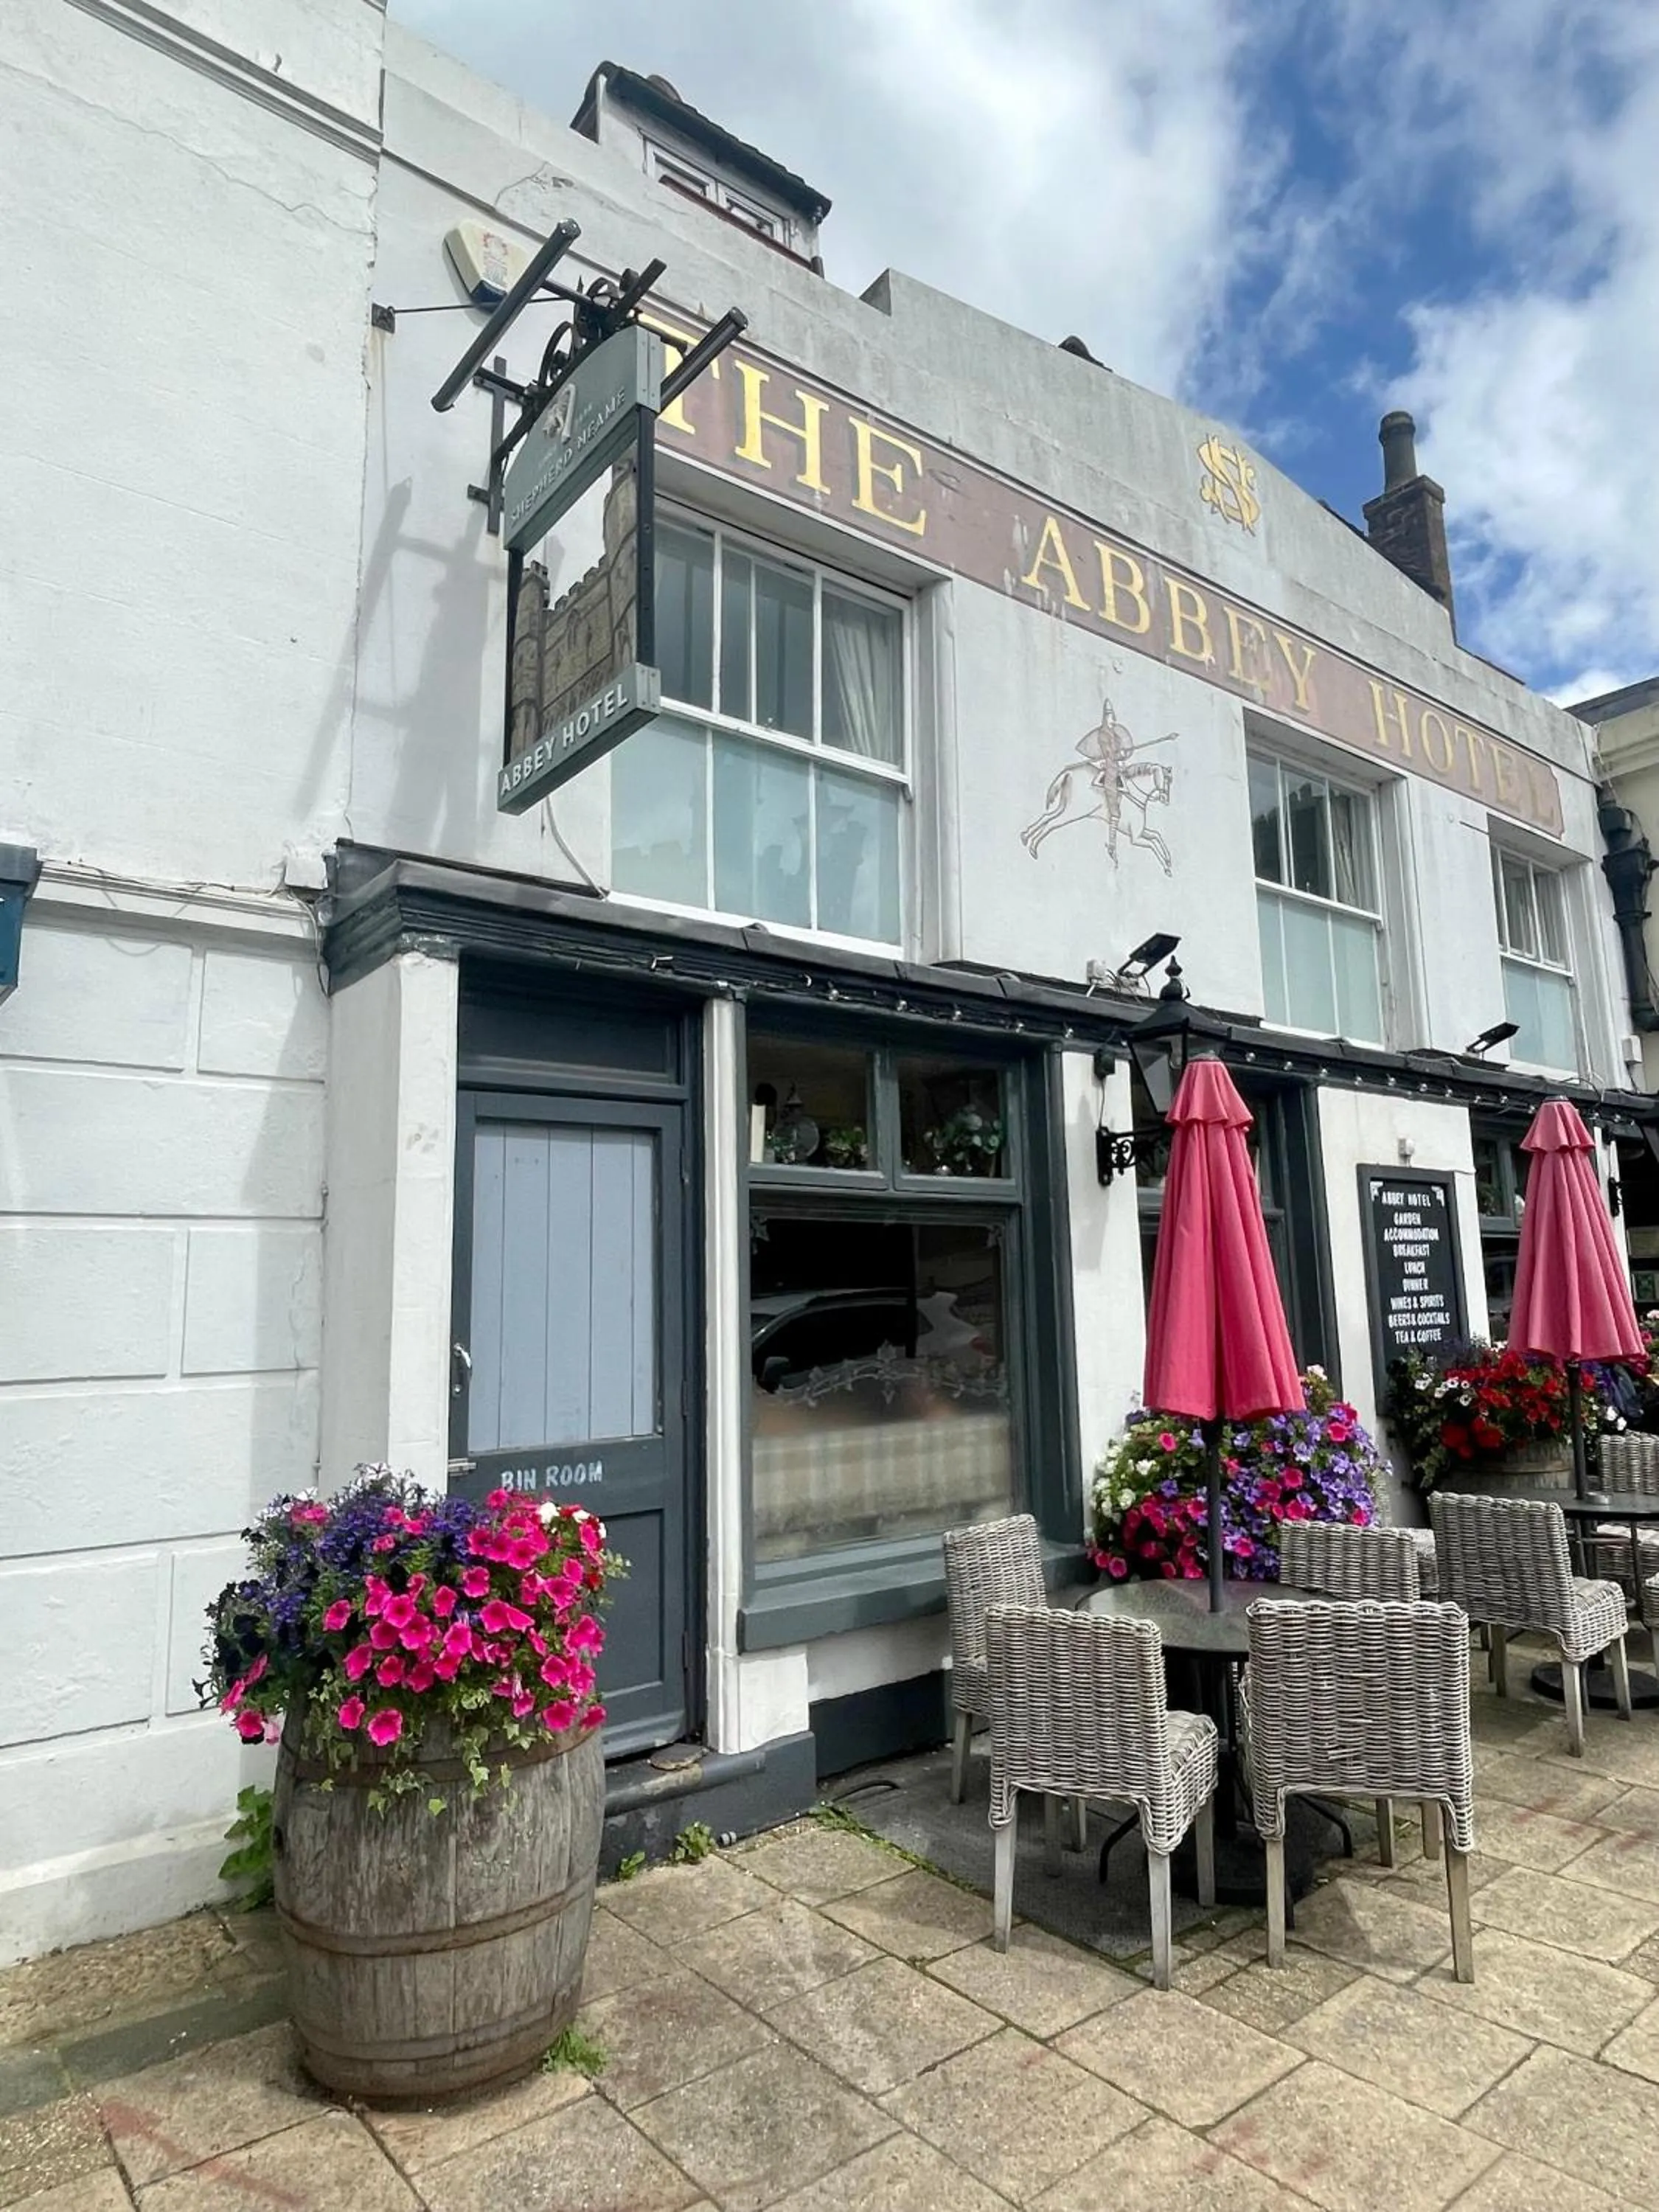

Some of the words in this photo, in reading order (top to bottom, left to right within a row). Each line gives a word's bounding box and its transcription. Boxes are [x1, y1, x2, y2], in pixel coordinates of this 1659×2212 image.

[639, 312, 926, 538] THE
[1021, 515, 1317, 712] ABBEY
[1368, 680, 1554, 827] HOTEL
[501, 737, 555, 795] ABBEY
[563, 684, 627, 747] HOTEL
[1381, 1191, 1405, 1206] ABBEY
[1408, 1193, 1431, 1207] HOTEL
[1393, 1243, 1430, 1258] BREAKFAST
[1403, 1261, 1425, 1275] LUNCH
[1390, 1296, 1411, 1310] WINES
[1419, 1294, 1444, 1309] SPIRITS
[1416, 1312, 1450, 1326] COCKTAILS
[1395, 1330, 1409, 1344] TEA
[1416, 1328, 1442, 1343] COFFEE
[501, 1468, 536, 1492] BIN
[546, 1460, 602, 1488] ROOM
